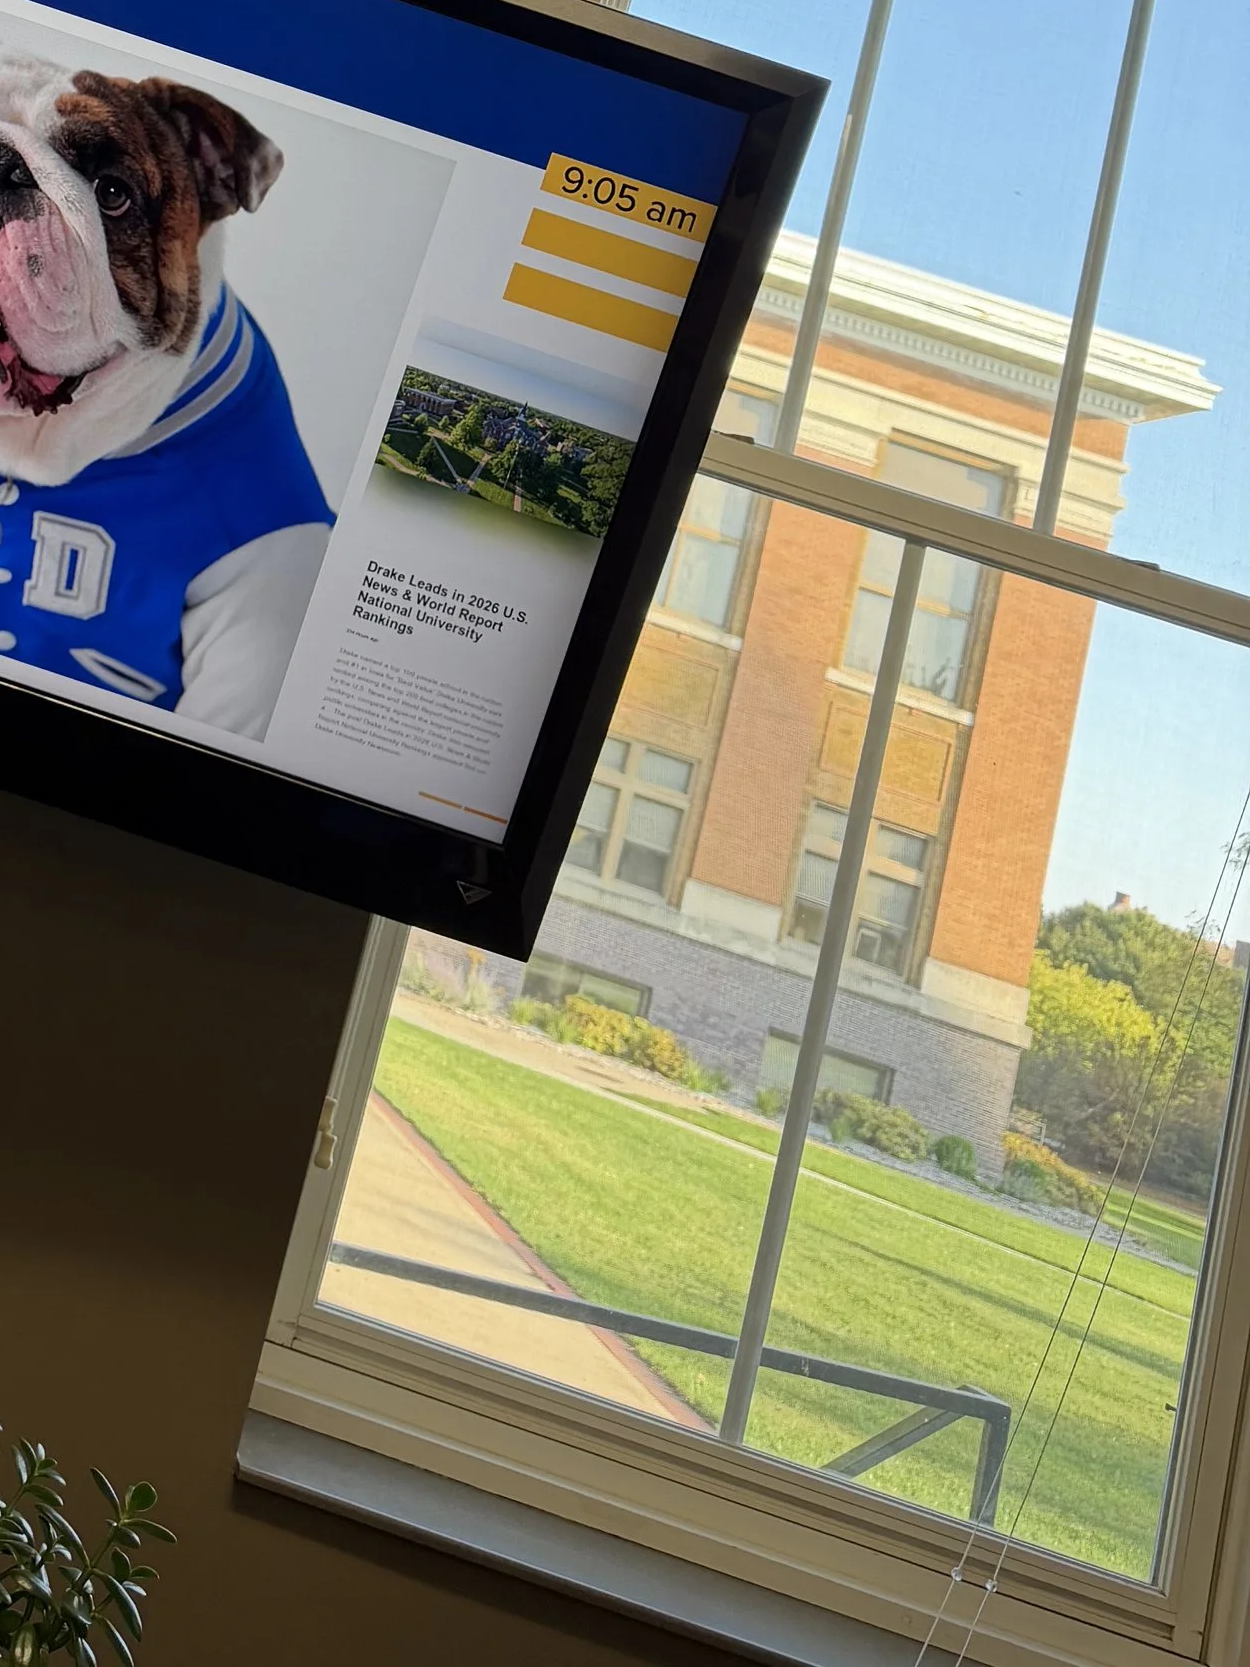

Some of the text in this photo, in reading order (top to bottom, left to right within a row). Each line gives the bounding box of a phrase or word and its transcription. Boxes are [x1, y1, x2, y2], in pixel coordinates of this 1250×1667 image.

[561, 166, 697, 233] 9:05 am
[22, 510, 116, 621] D
[367, 560, 529, 624] Drake Leads in 2026 U.S.
[352, 605, 414, 636] Rankings
[357, 590, 412, 619] National
[416, 609, 483, 644] University
[362, 575, 503, 633] News & World Report
